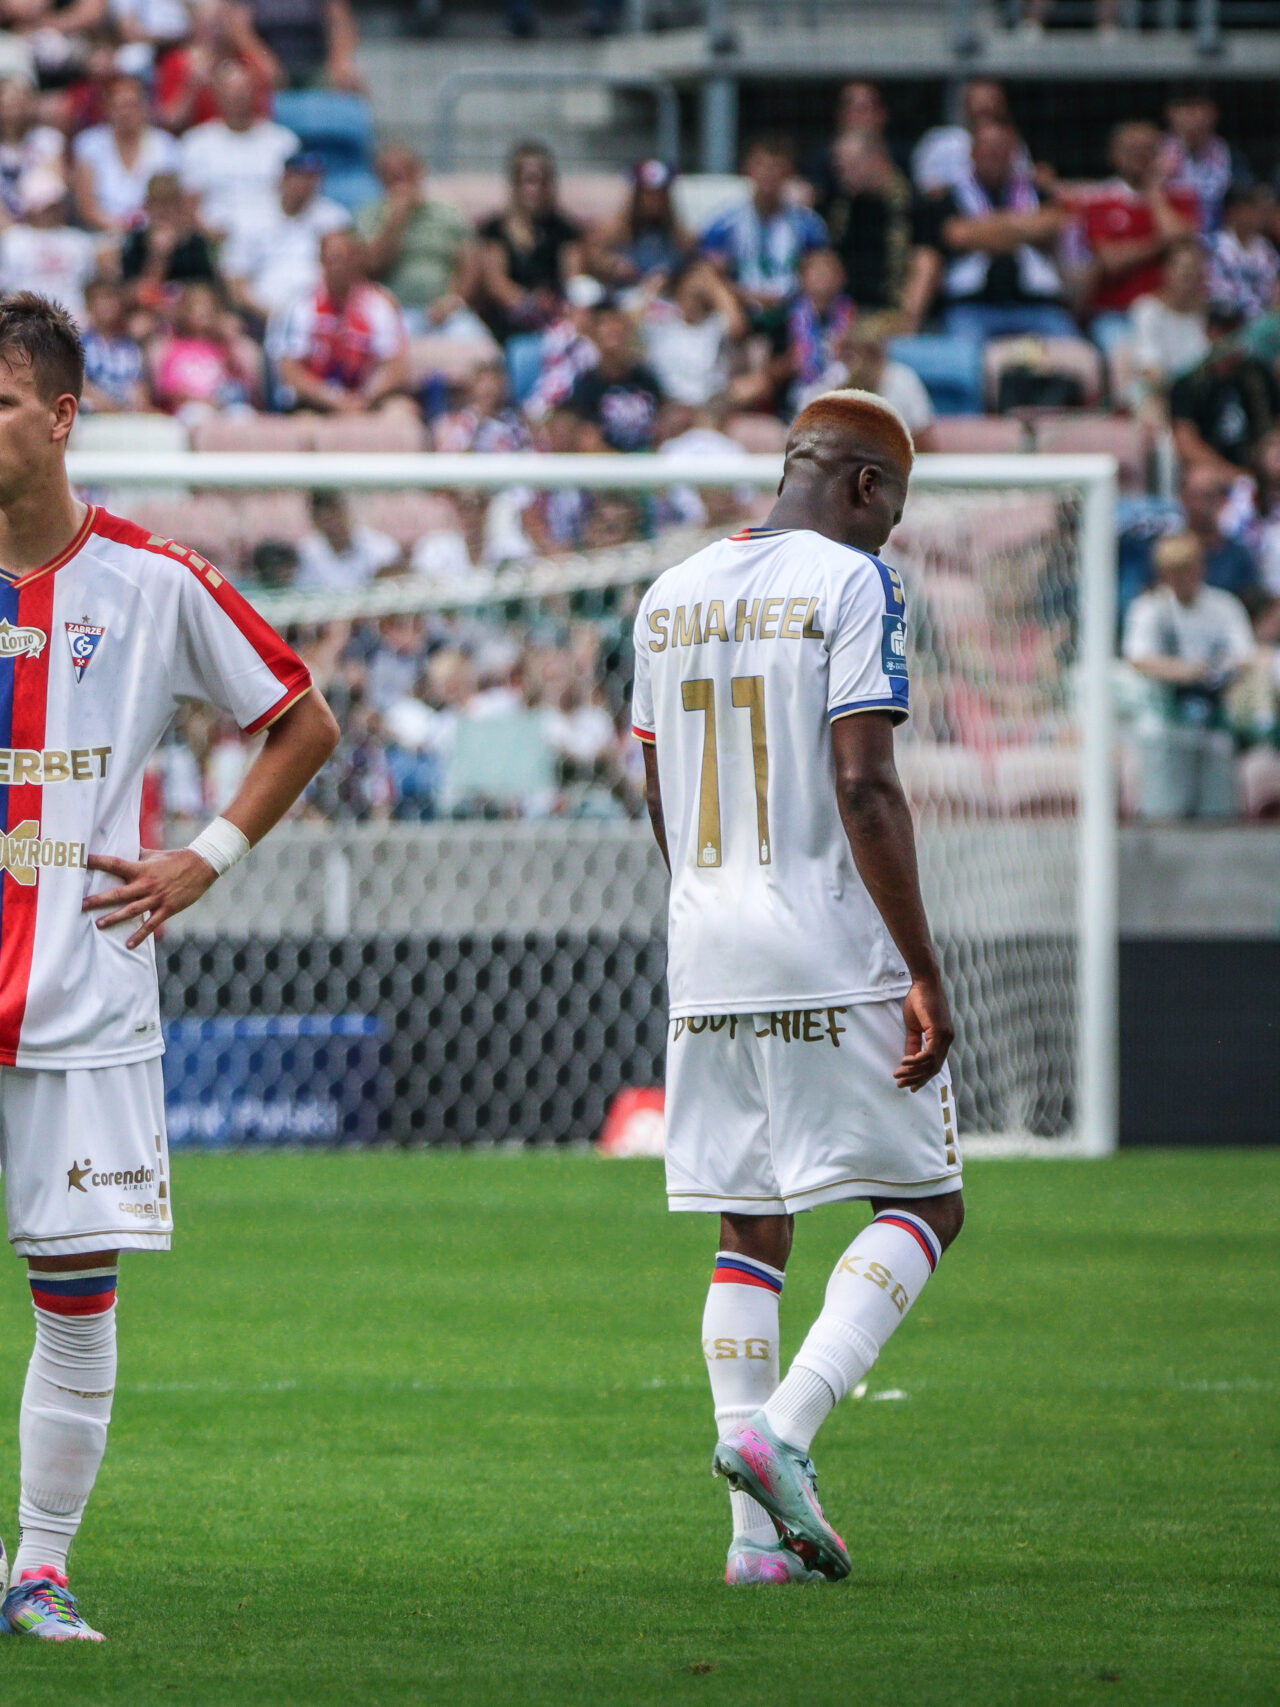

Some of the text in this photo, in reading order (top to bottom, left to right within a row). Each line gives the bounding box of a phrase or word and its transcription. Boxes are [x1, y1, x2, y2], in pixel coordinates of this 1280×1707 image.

[1, 634, 34, 650] LOTTO
[67, 624, 102, 635] ZABRZE
[646, 597, 825, 652] SMAHEEL
[681, 675, 771, 867] 11
[123, 1183, 154, 1191] AIRLIN
[837, 1256, 910, 1314] KSG
